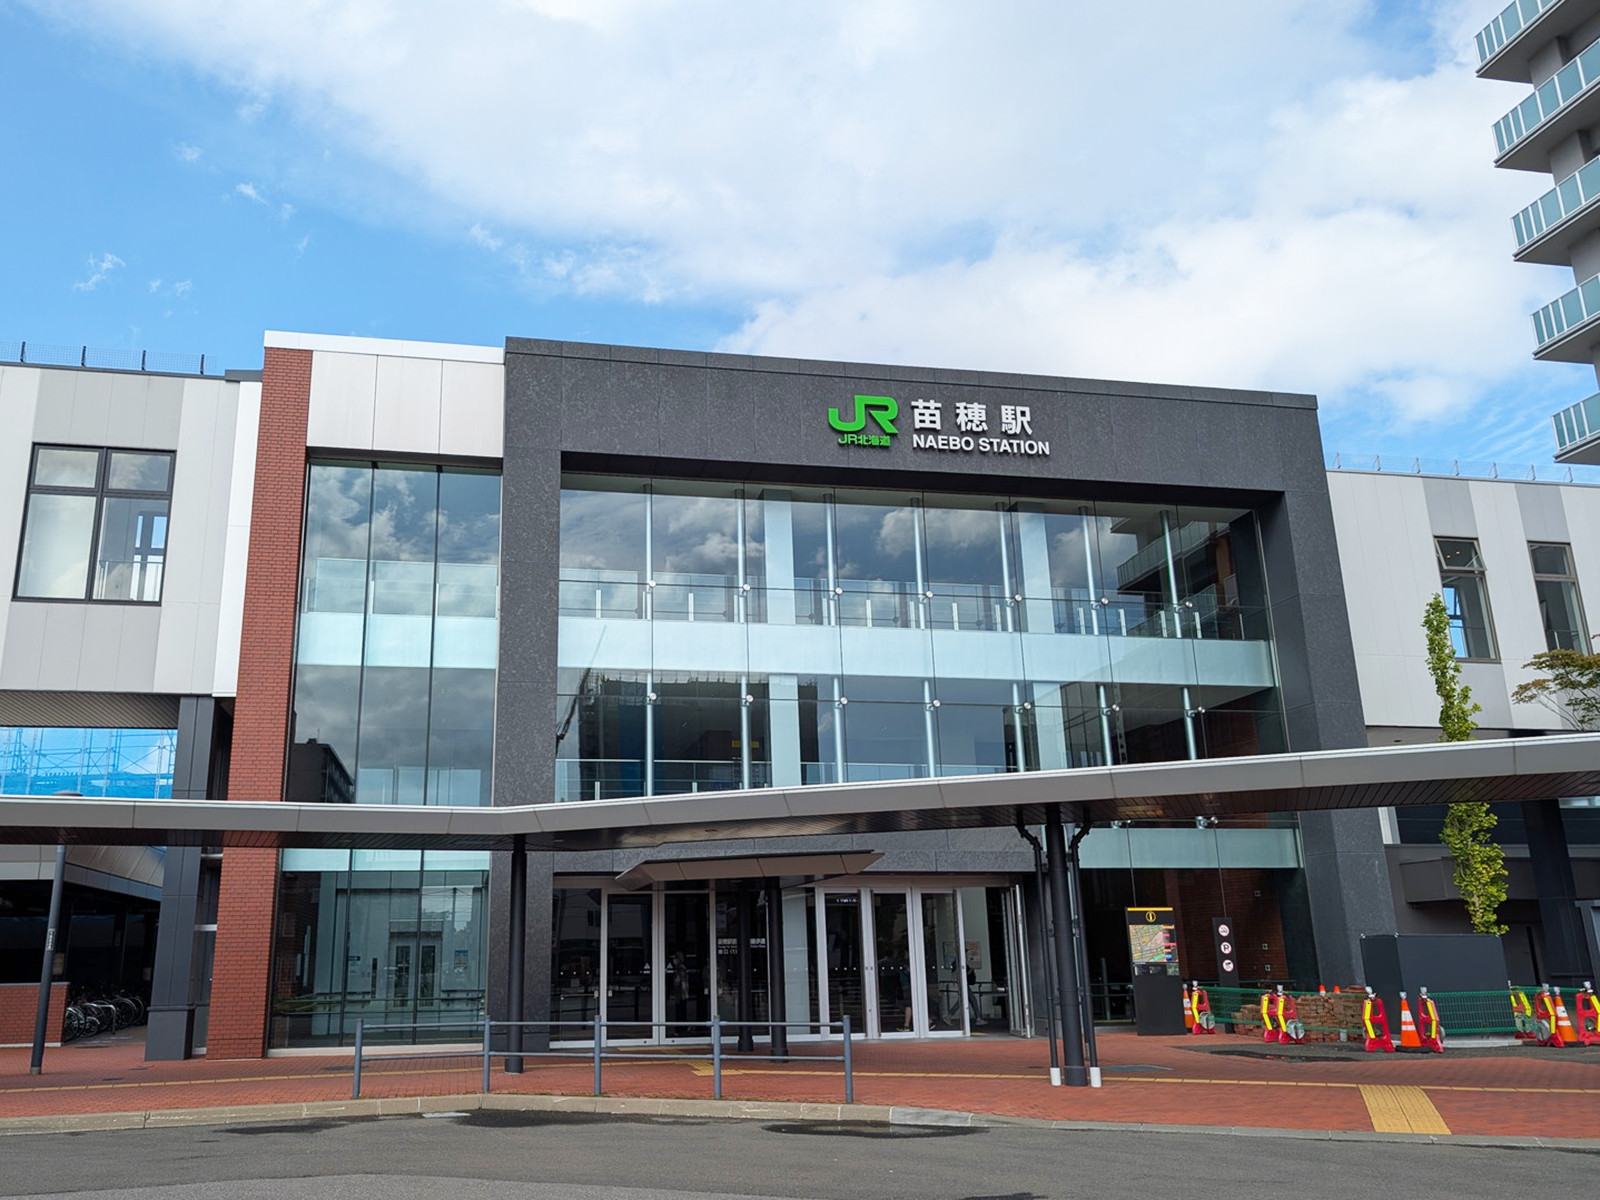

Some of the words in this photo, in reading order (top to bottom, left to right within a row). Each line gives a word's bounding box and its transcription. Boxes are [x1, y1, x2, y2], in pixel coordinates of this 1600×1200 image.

[828, 395, 899, 434] JR
[911, 399, 1033, 436] 苗穂駅
[838, 433, 891, 447] JR北海道
[912, 433, 975, 451] NAEBO
[978, 437, 1050, 455] STATION
